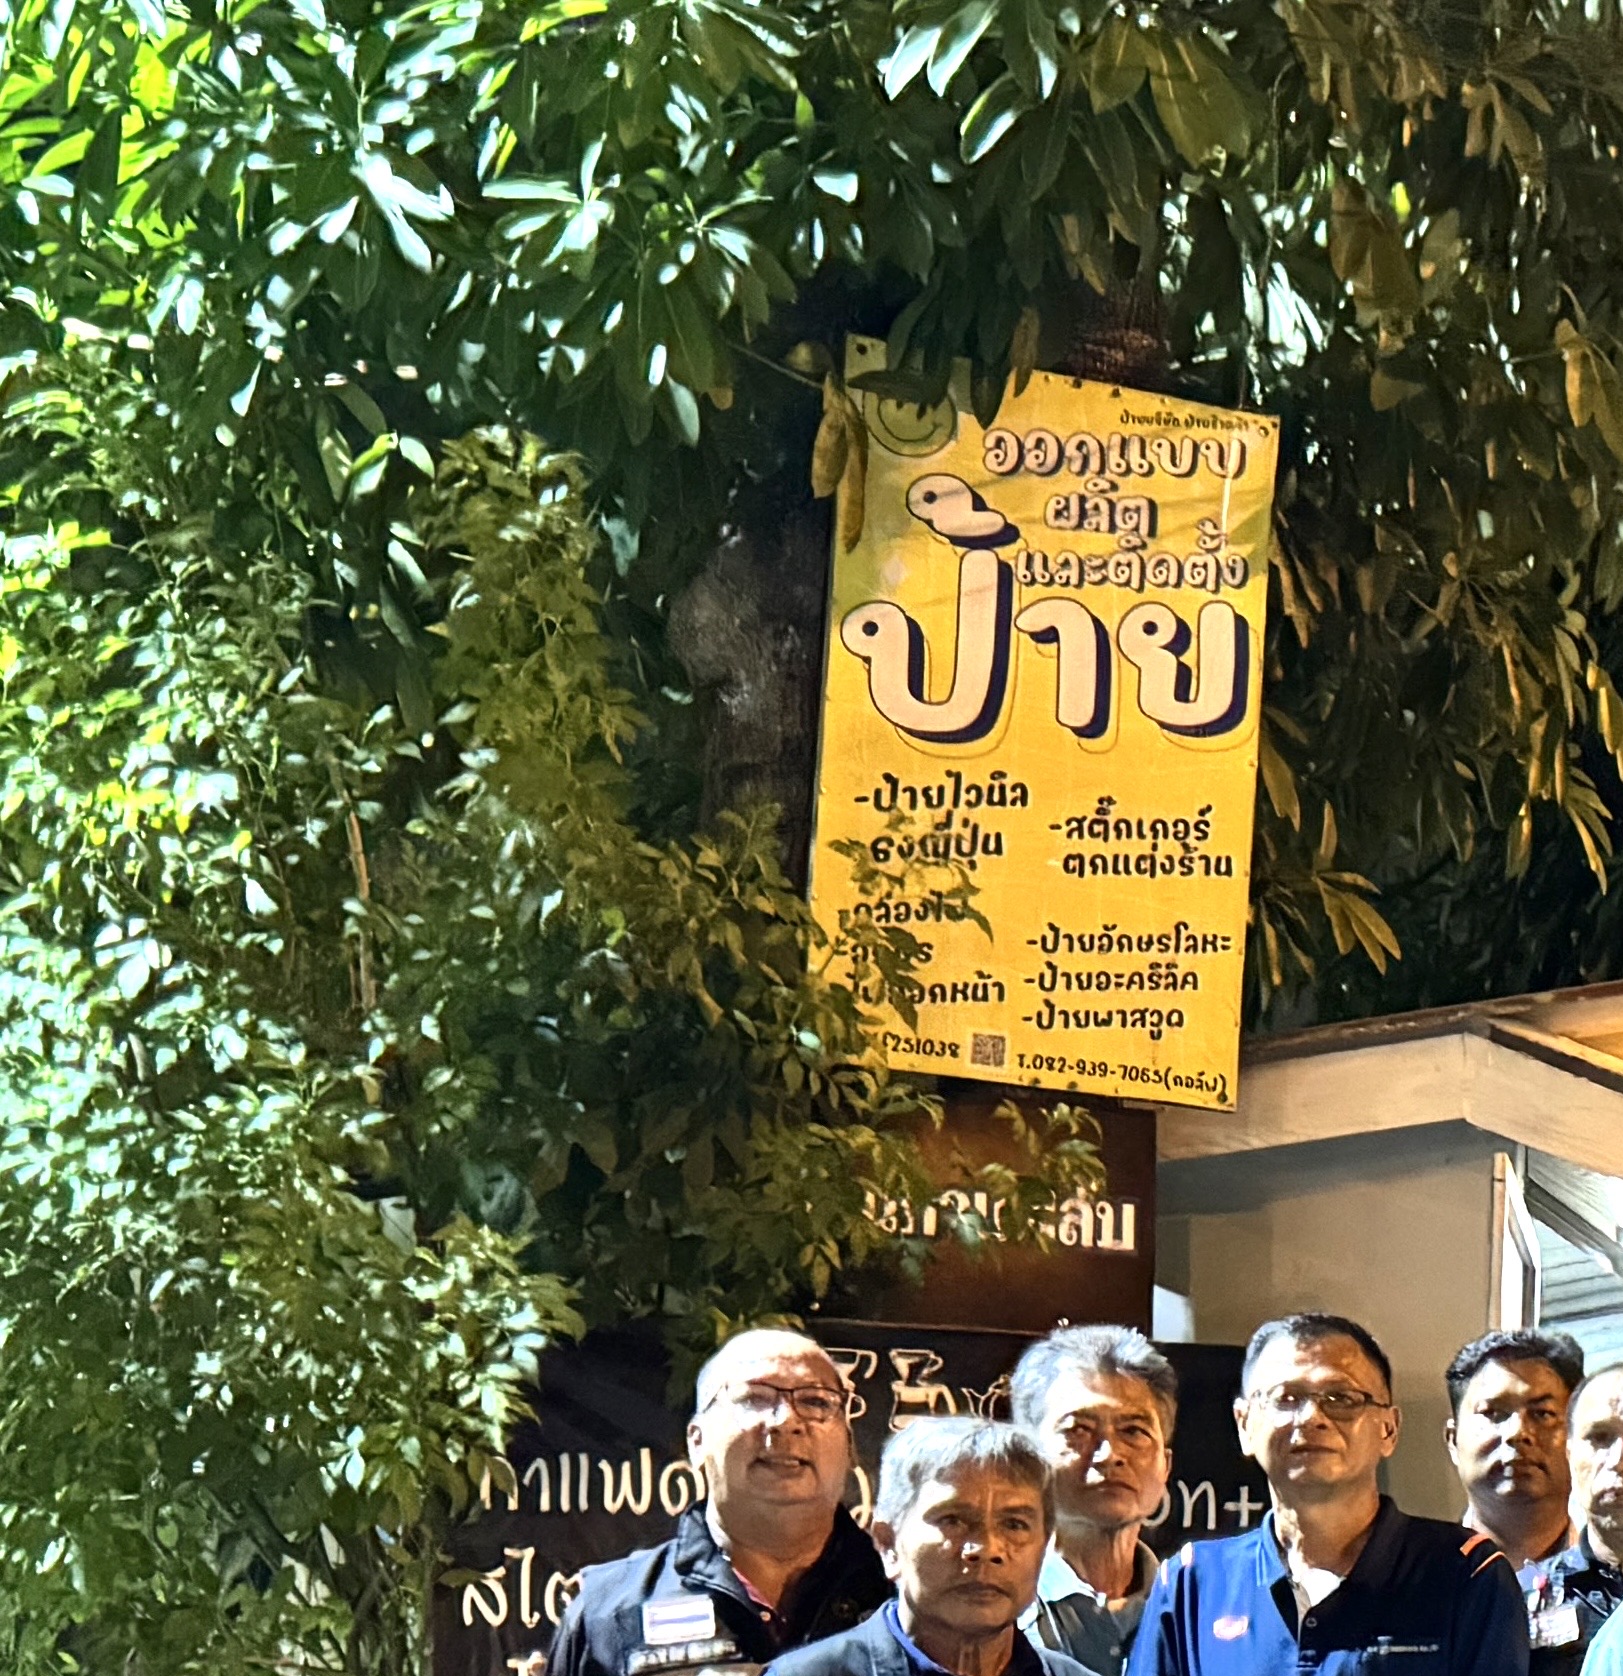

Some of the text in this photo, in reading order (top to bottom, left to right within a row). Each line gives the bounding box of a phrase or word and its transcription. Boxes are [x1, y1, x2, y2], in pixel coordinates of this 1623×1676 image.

[982, 429, 1248, 478] ออกแบบ
[1045, 477, 1156, 537] ผลิต
[1015, 518, 1248, 592] และติดตั้ง
[840, 473, 1249, 743] ป้าย
[1062, 842, 1233, 879] ตกแต่งร้าน
[1026, 921, 1232, 955] -ป้ายอักษรโลหะ
